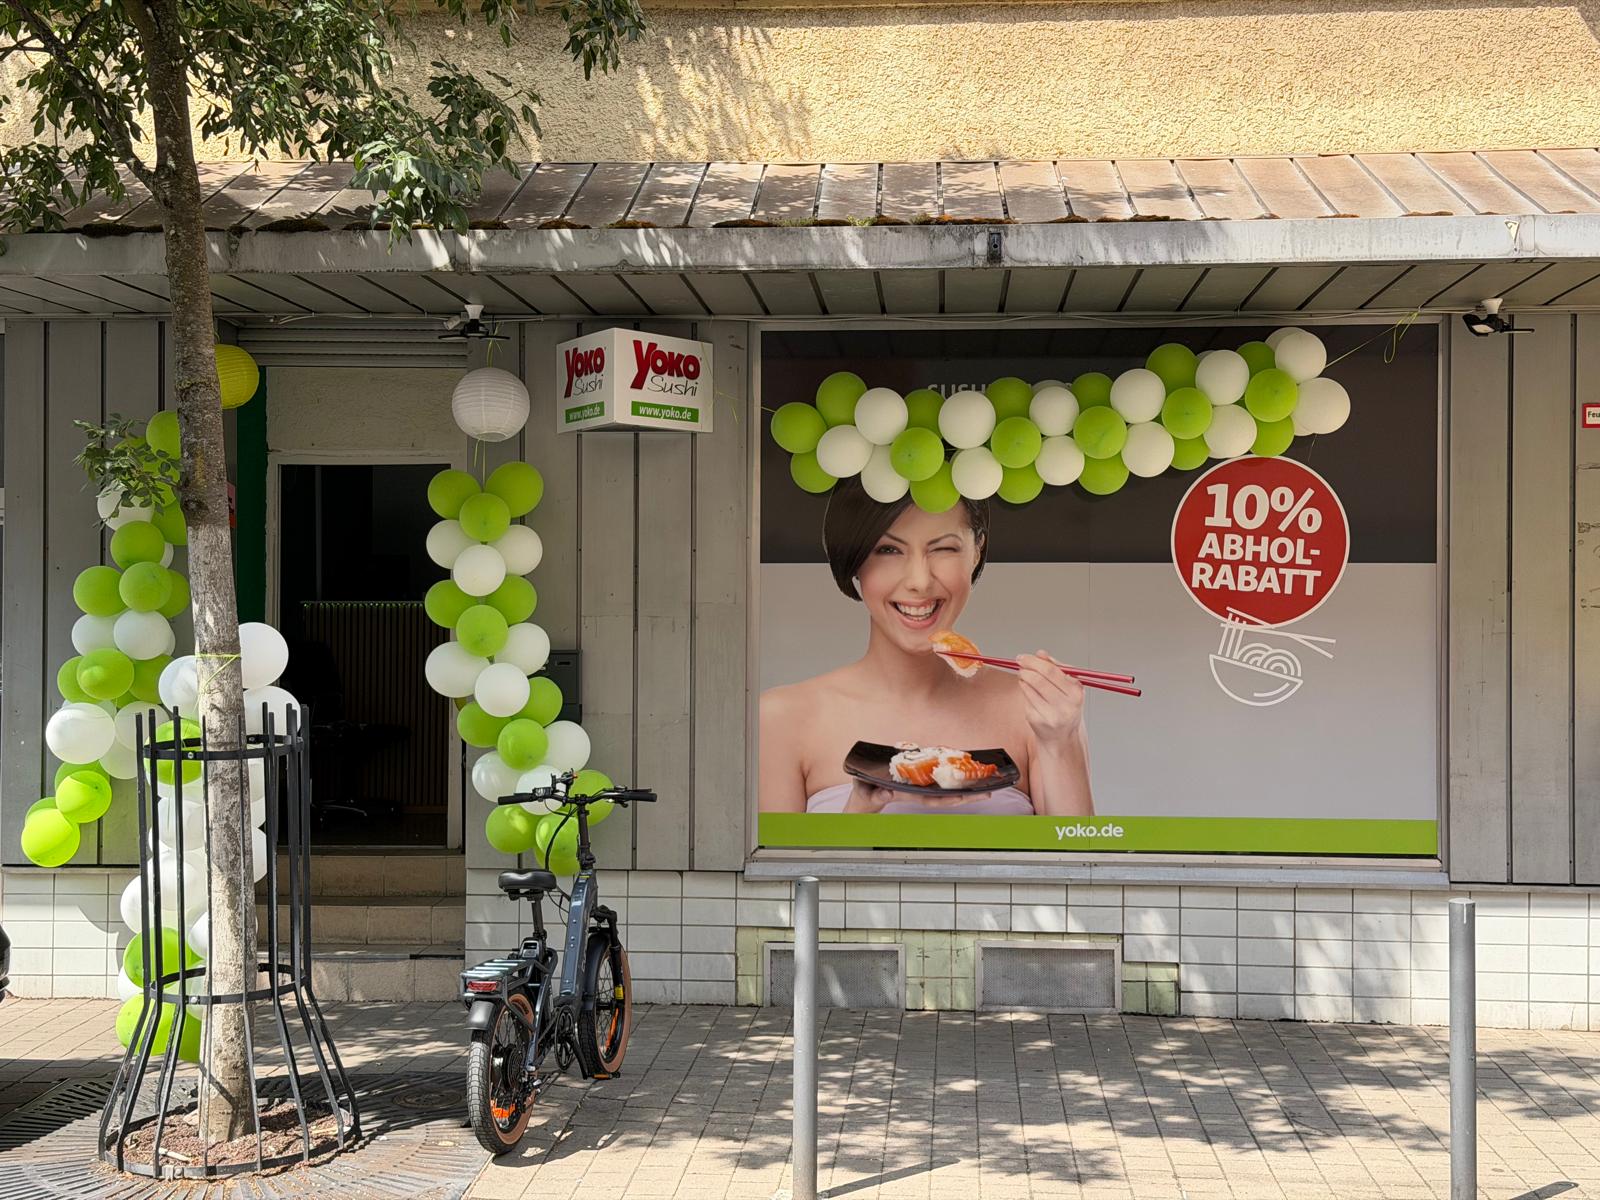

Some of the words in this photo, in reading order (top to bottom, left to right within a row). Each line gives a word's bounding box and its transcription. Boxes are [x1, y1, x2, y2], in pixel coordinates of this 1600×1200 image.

[573, 374, 604, 396] Sushi
[647, 375, 698, 396] Sushi
[569, 405, 601, 420] www.yoko.de
[639, 405, 692, 420] www.yoko.de
[1204, 483, 1322, 534] 10%
[1198, 532, 1321, 565] ABHOL-
[1191, 562, 1322, 596] RABATT
[1055, 823, 1124, 840] yoko.de
